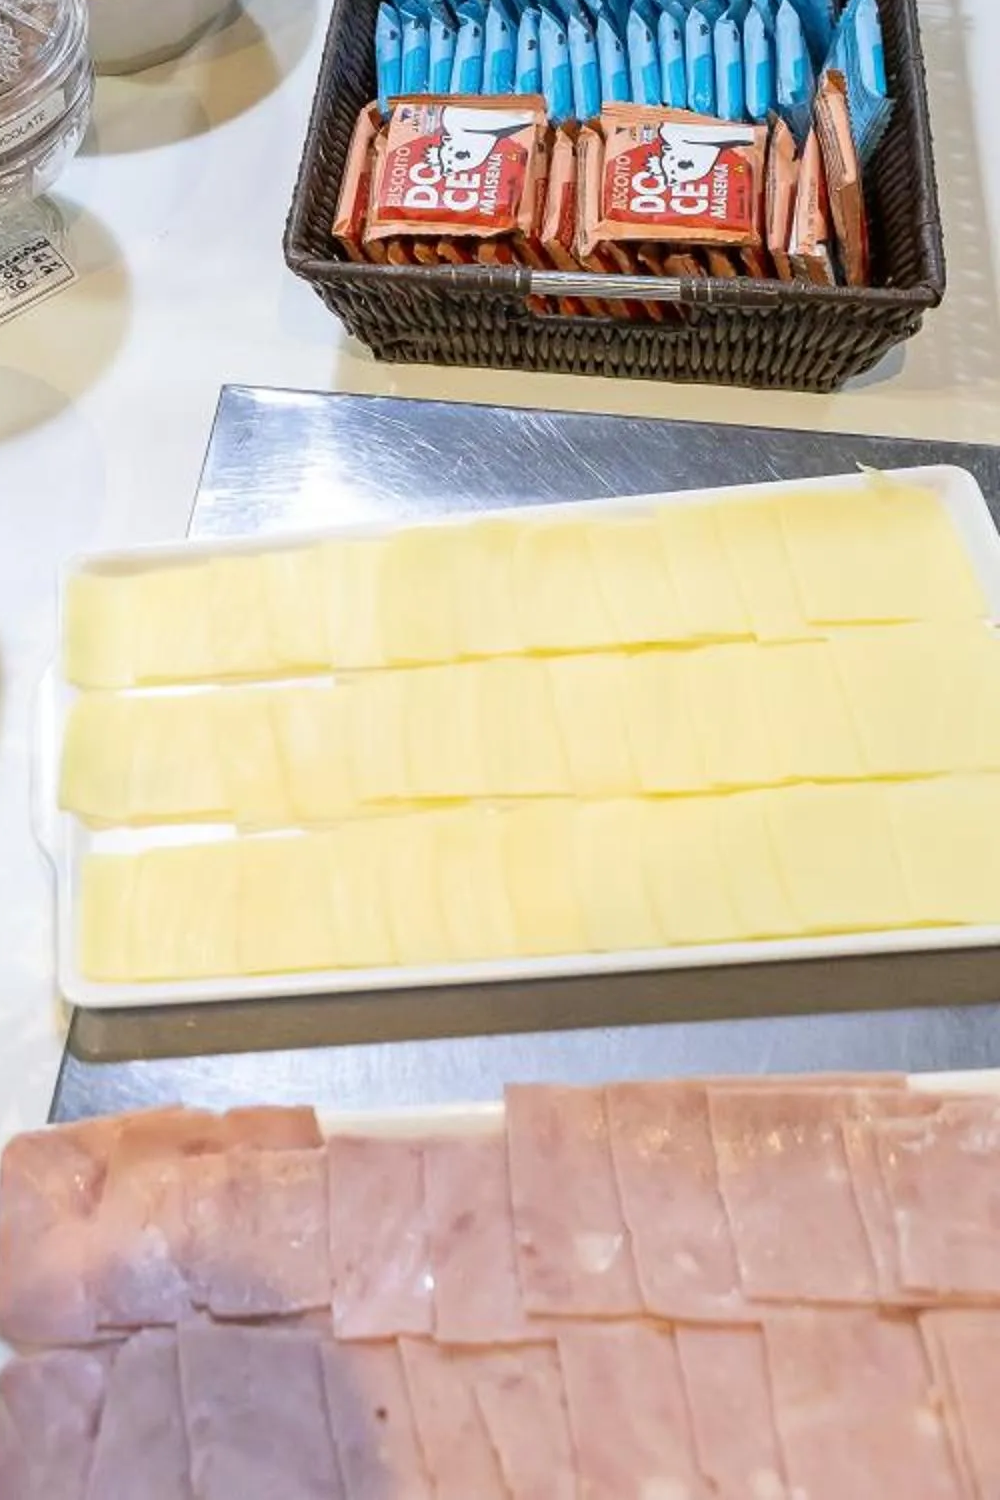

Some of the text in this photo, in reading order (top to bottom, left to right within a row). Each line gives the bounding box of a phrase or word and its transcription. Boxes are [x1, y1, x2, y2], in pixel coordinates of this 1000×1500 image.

[387, 147, 411, 207] BISCOITO
[403, 161, 441, 208] DO
[442, 171, 481, 212] CE
[479, 152, 503, 216] MAISENA
[611, 155, 632, 210] BISCOITO
[630, 171, 667, 213] DO
[669, 182, 709, 215] CE
[709, 163, 729, 220] MAISENA
